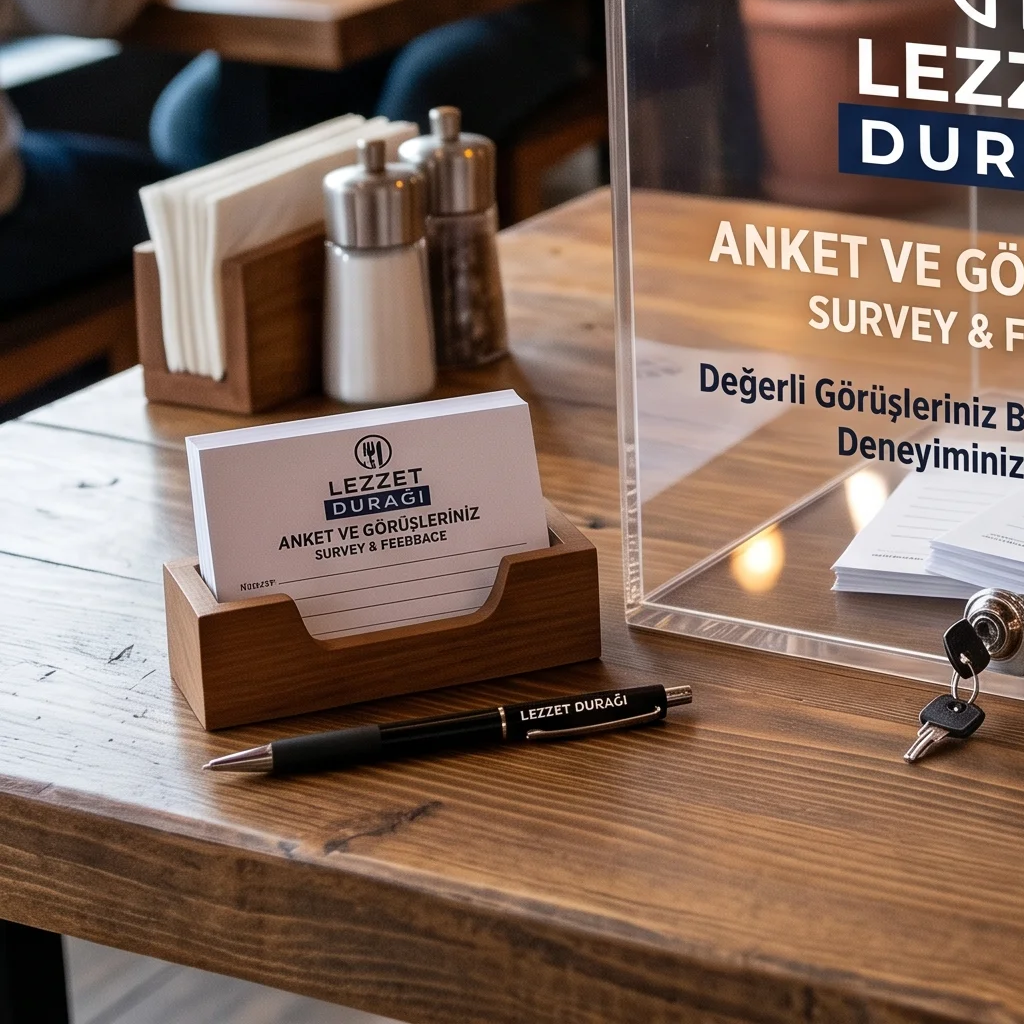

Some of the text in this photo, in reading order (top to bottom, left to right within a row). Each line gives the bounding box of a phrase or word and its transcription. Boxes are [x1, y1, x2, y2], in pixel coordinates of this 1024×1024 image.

[709, 220, 868, 280] ANKET
[880, 238, 942, 288] VE
[808, 295, 959, 346] SURVEY
[967, 313, 994, 350] &
[699, 362, 806, 406] Değerli
[815, 377, 997, 429] Görüşleriniz
[329, 467, 423, 496] LEZZET
[332, 488, 425, 516] DURAĞI
[278, 505, 481, 551] ANKET VE GÖRÜŞLERİNİZ
[315, 542, 366, 560] SURVEY
[369, 541, 378, 552] &
[520, 693, 628, 721] LEZZET DURAĞI
